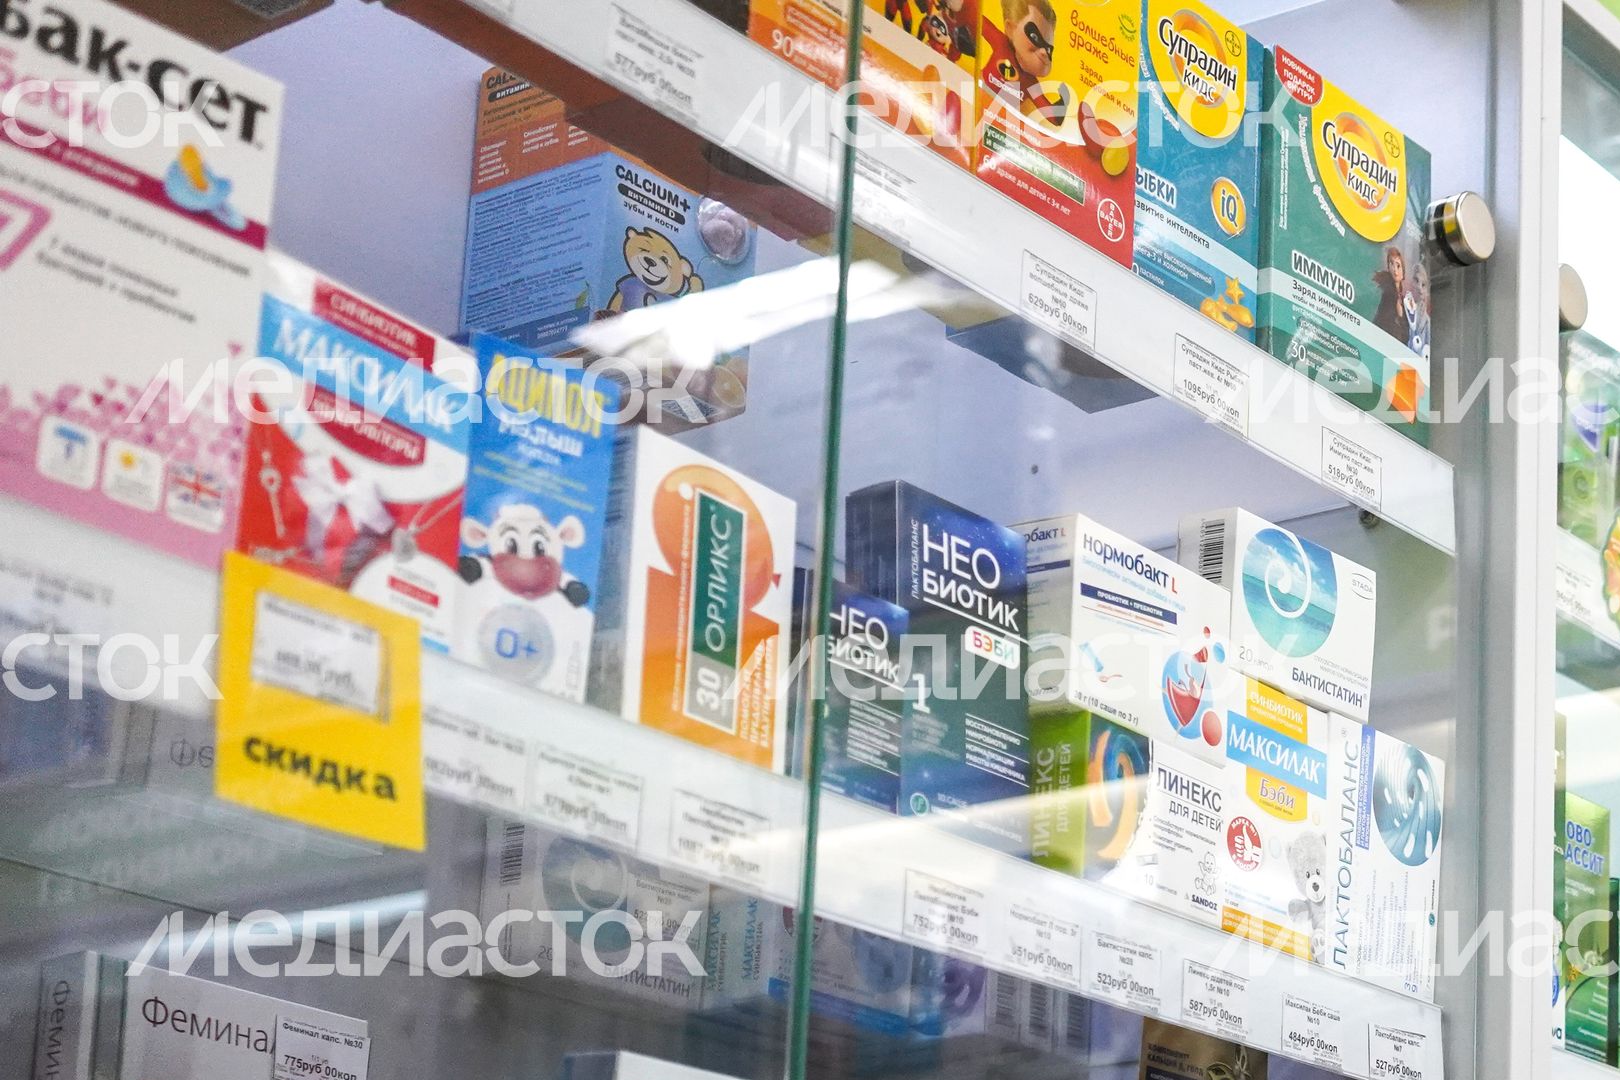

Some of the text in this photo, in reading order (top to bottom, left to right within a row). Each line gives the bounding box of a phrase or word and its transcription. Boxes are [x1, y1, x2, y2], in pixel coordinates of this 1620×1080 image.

[1069, 30, 1109, 64] драже
[1070, 10, 1136, 68] волшебные
[1159, 18, 1237, 91] Супрадин
[1283, 69, 1315, 96] ПОДАРОК
[1323, 122, 1396, 193] Супрадин
[615, 164, 691, 212] CALCIUM+
[627, 188, 668, 216] витамин
[623, 200, 679, 233] зубы кости
[1167, 217, 1210, 249] интеллекта
[1294, 252, 1353, 301] ИММУНО
[1028, 293, 1087, 334] 629руб 00коп
[1293, 280, 1361, 326] Заряд иммунитета
[1291, 341, 1306, 362] 30
[1184, 379, 1215, 404] 1095руб
[1329, 464, 1353, 484] 518руб
[922, 523, 1000, 590] НЕО
[704, 512, 733, 653] ОРЛИКС
[922, 569, 1019, 631] БИОТИК
[972, 631, 1016, 664] БЭБИ
[696, 667, 722, 711] 30
[1292, 667, 1363, 708] БАКТИСТАТИН
[243, 735, 397, 802] скидка
[1229, 724, 1319, 784] МАКСИЛАК
[1157, 768, 1222, 813] ЛИНЕКС
[1192, 811, 1221, 833] ДЕТЕЙ
[1331, 739, 1360, 969] ЛАКТОБАЛАНС
[1565, 844, 1604, 876] АССИТ
[1191, 894, 1218, 911] SANDOZ
[1097, 972, 1154, 996] 523руб 00коп
[1189, 1000, 1242, 1025] 587руб 00коп
[283, 1022, 363, 1049] Феминал капс. №30
[1288, 1031, 1338, 1054] 484руб 00коп
[284, 1054, 322, 1074] 775руб
[1375, 1059, 1422, 1080] 527руб 00коп
